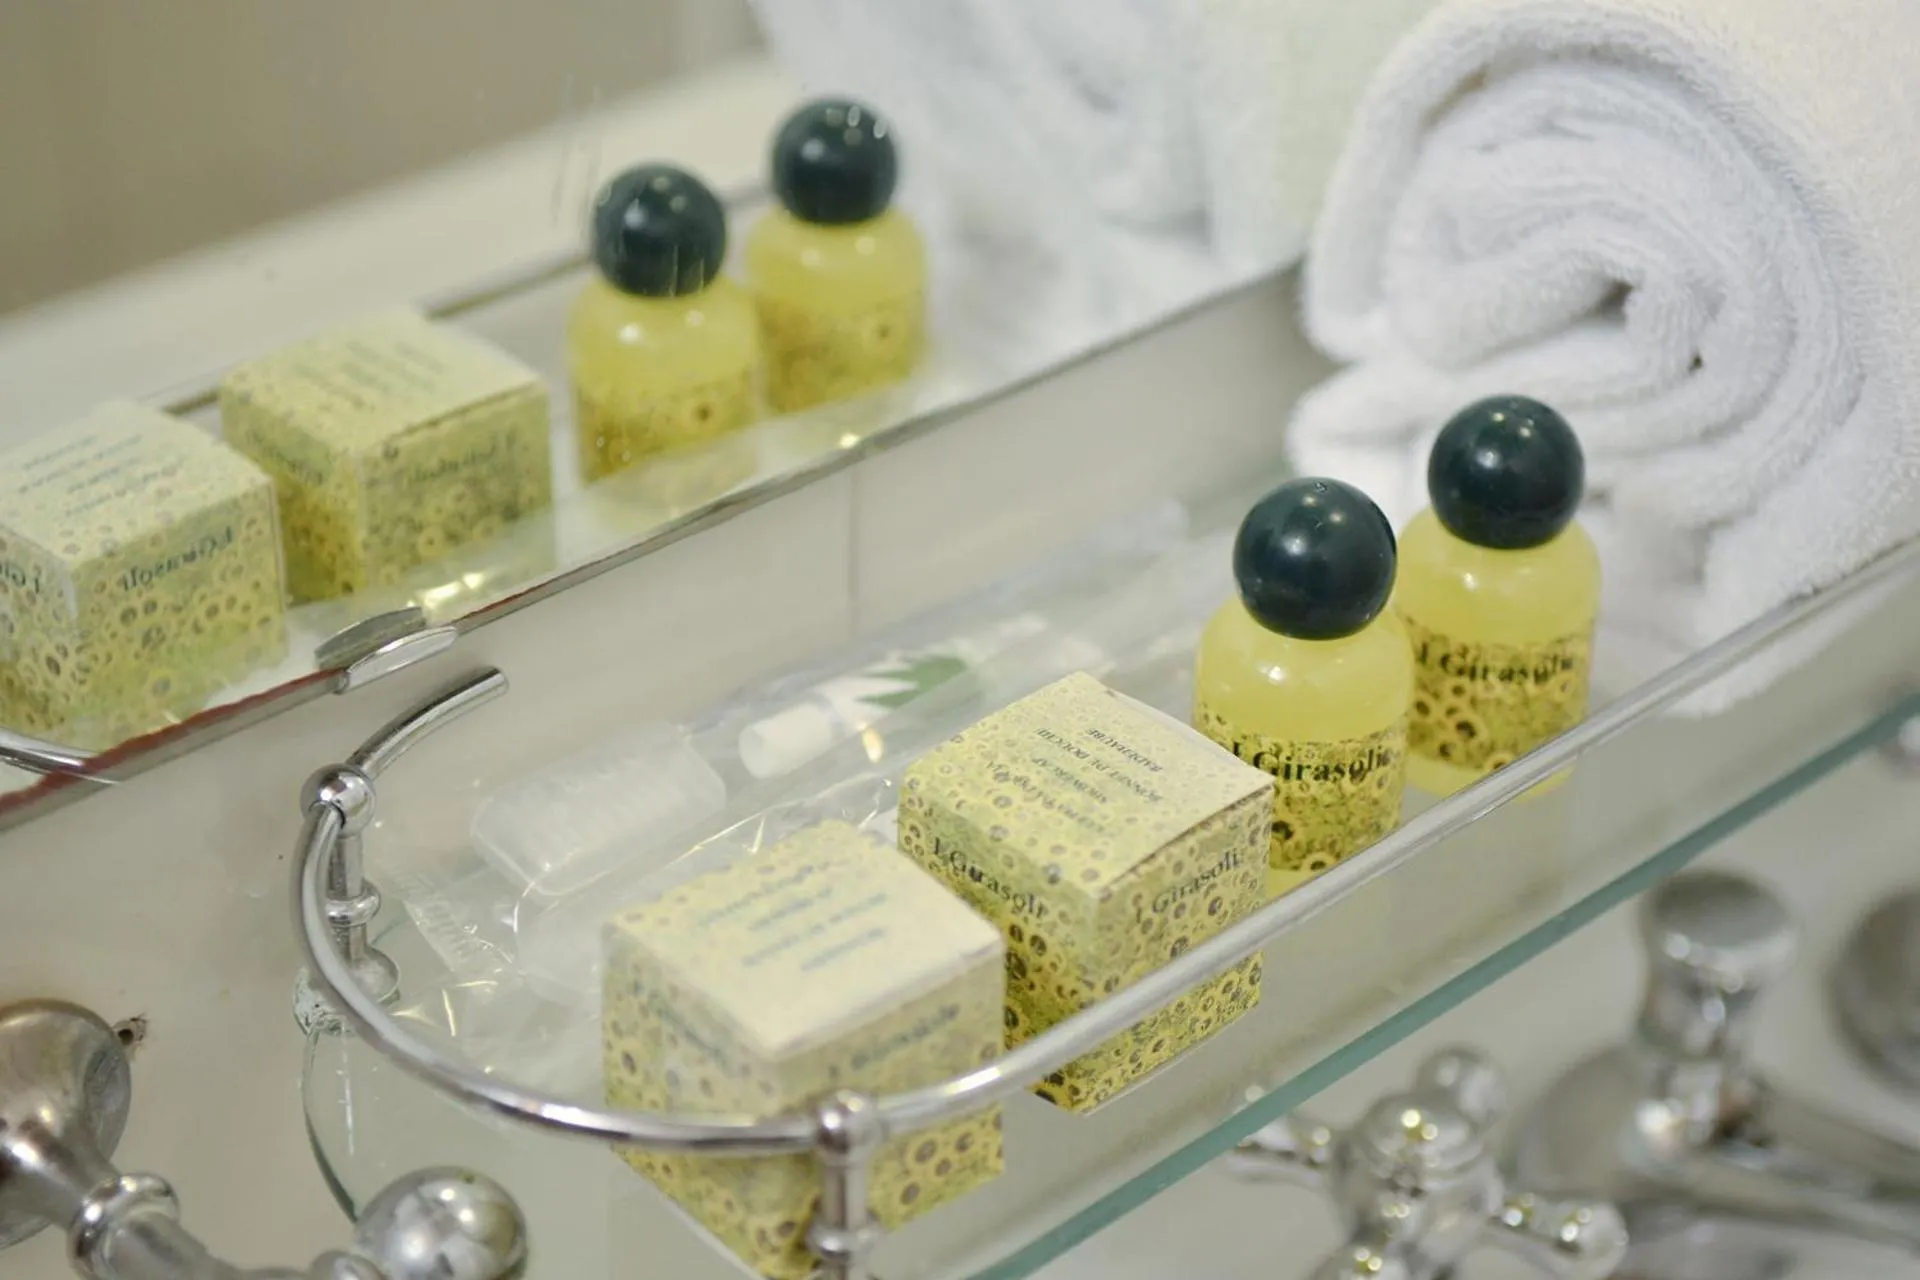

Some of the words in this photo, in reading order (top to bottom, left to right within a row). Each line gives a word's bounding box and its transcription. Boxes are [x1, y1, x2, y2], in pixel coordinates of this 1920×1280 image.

[1252, 744, 1386, 784] Girasoli
[949, 850, 1046, 919] Girasoli
[1151, 846, 1239, 915] Girasoli
